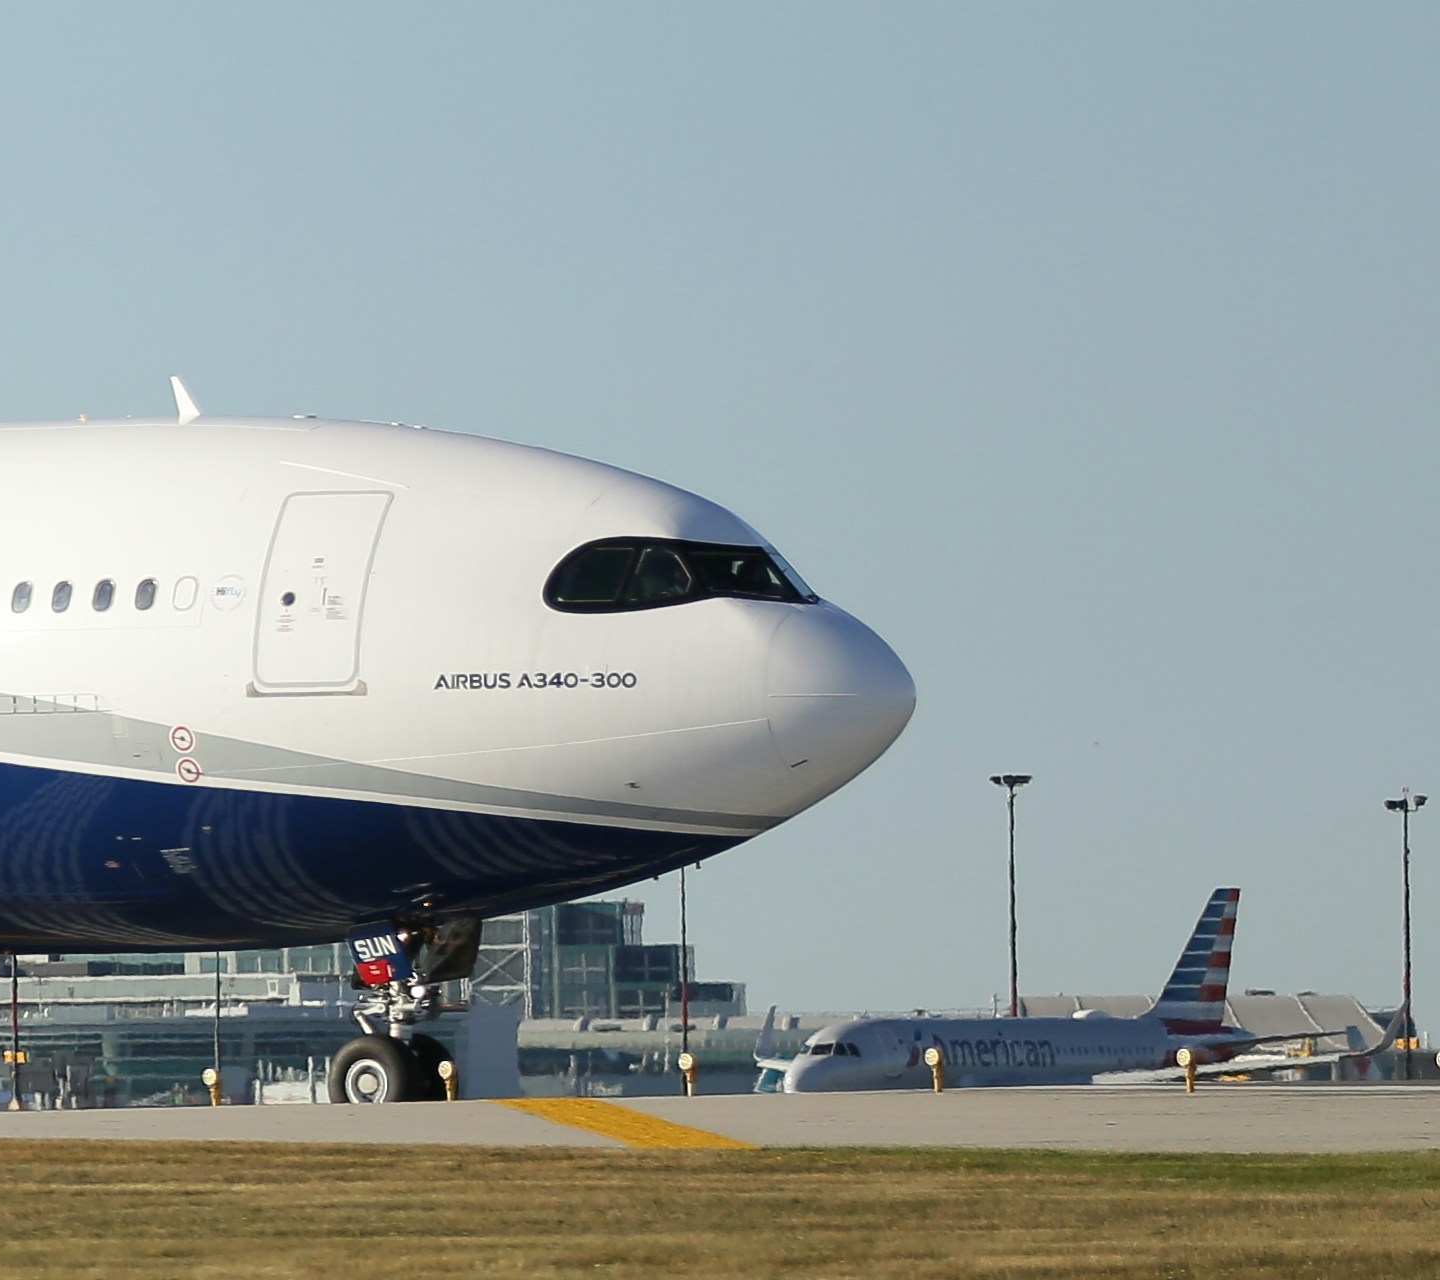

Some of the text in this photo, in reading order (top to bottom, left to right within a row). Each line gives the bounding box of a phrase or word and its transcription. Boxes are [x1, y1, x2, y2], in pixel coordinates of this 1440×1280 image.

[434, 672, 637, 690] AIRBUS A340-300
[353, 934, 397, 959] SUN
[931, 1031, 1056, 1068] American
